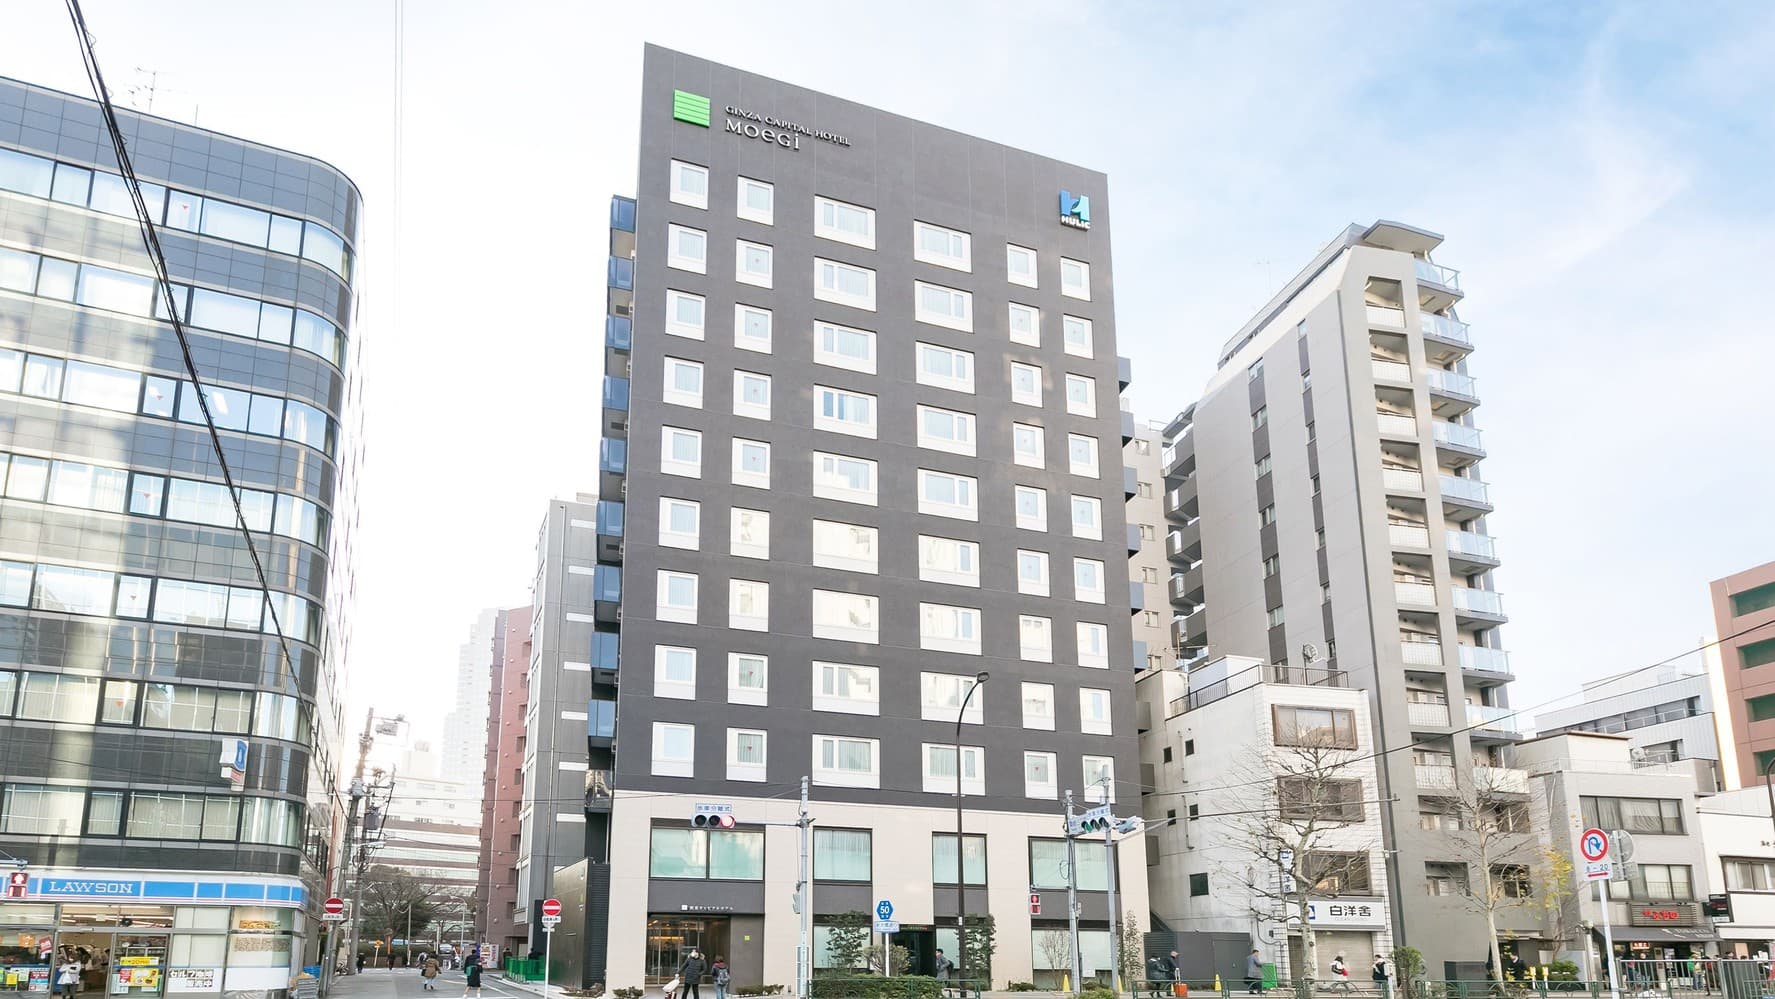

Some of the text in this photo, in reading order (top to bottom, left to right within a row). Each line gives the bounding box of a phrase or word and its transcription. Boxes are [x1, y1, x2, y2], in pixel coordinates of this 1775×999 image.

[725, 105, 852, 146] GINZA CAPITAL HOTEL
[1061, 215, 1090, 229] HULIC
[49, 881, 133, 894] LAWSON
[880, 906, 890, 914] 50
